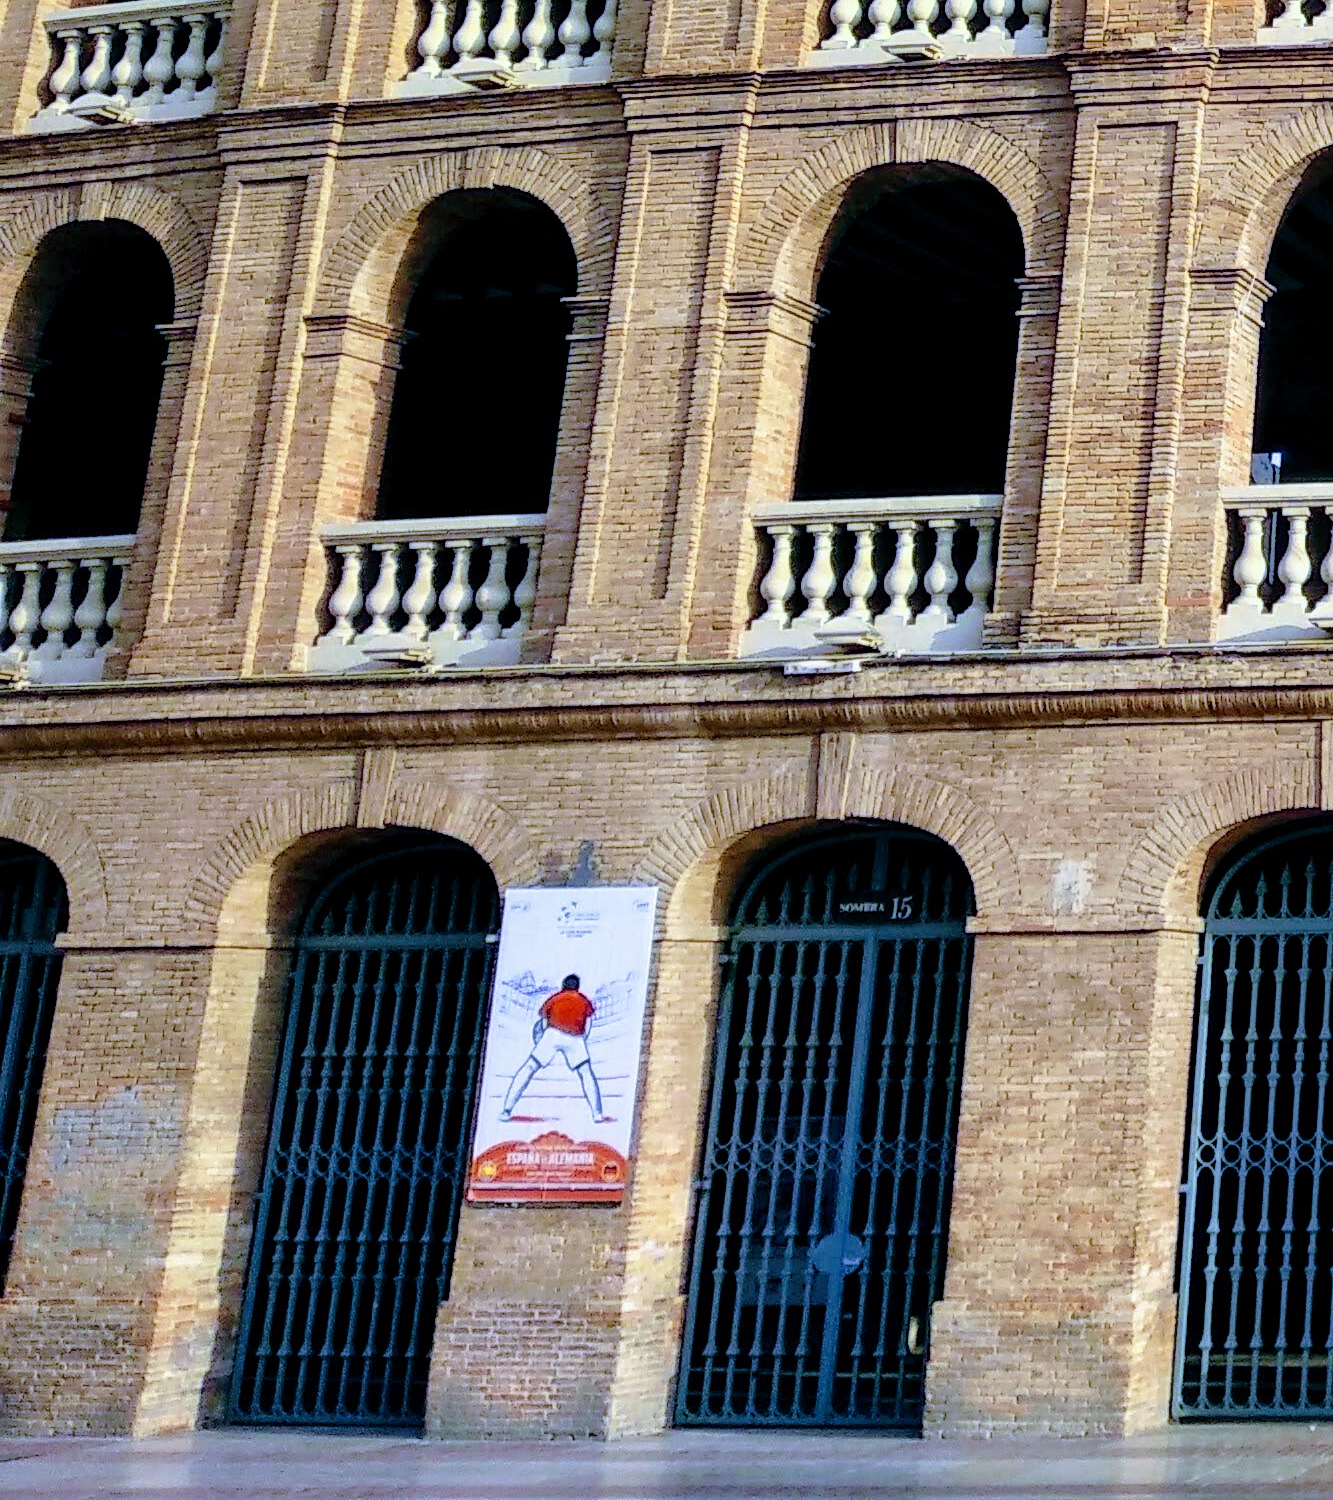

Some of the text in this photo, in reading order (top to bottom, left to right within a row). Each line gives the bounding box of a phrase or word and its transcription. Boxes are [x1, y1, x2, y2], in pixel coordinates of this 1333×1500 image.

[840, 896, 913, 920] SOMBRA 15
[506, 1151, 541, 1165] ESPAÑA
[548, 1151, 594, 1165] ALEMANIA
